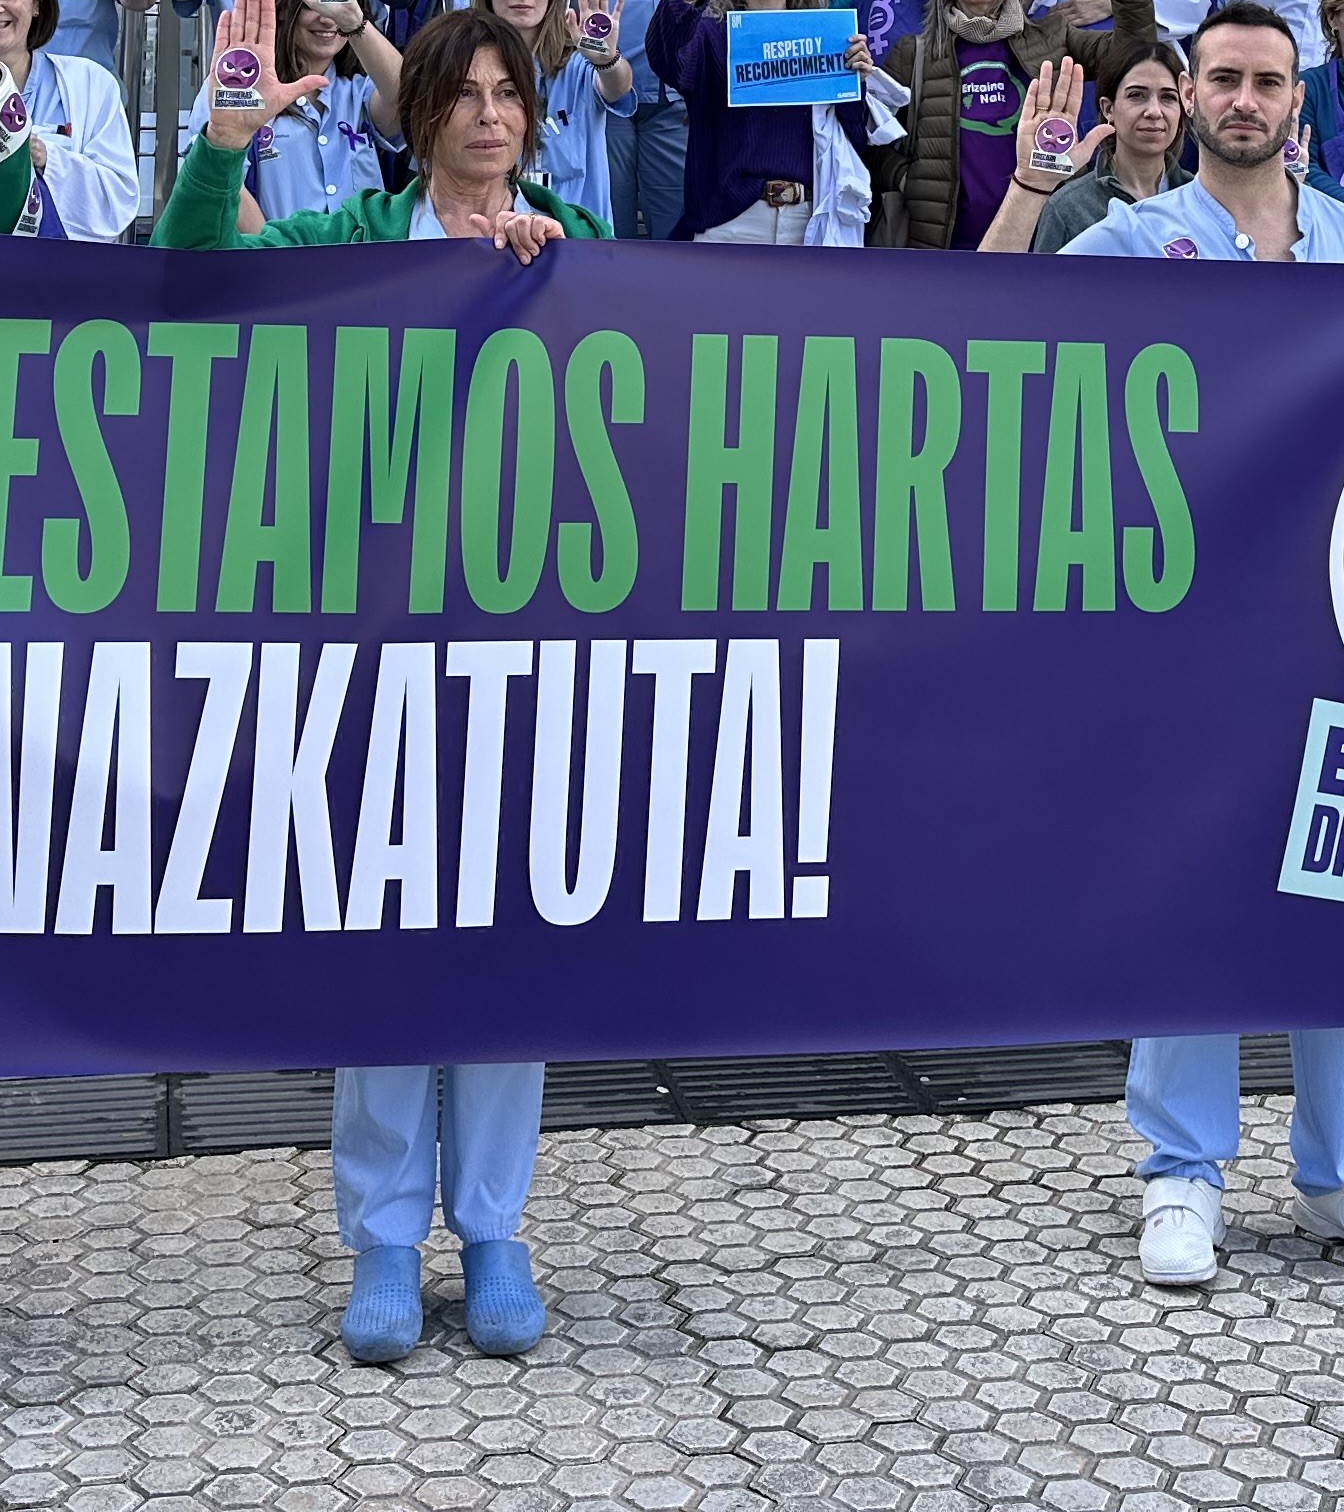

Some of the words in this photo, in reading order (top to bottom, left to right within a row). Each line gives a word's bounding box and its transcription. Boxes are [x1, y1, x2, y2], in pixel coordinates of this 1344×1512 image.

[763, 38, 813, 60] RESPETO
[814, 36, 822, 54] Y
[735, 53, 849, 83] RECONOCIMIENT
[962, 82, 1004, 94] Erizaina
[979, 92, 1006, 104] Naiz
[680, 332, 1200, 613] HARTAS
